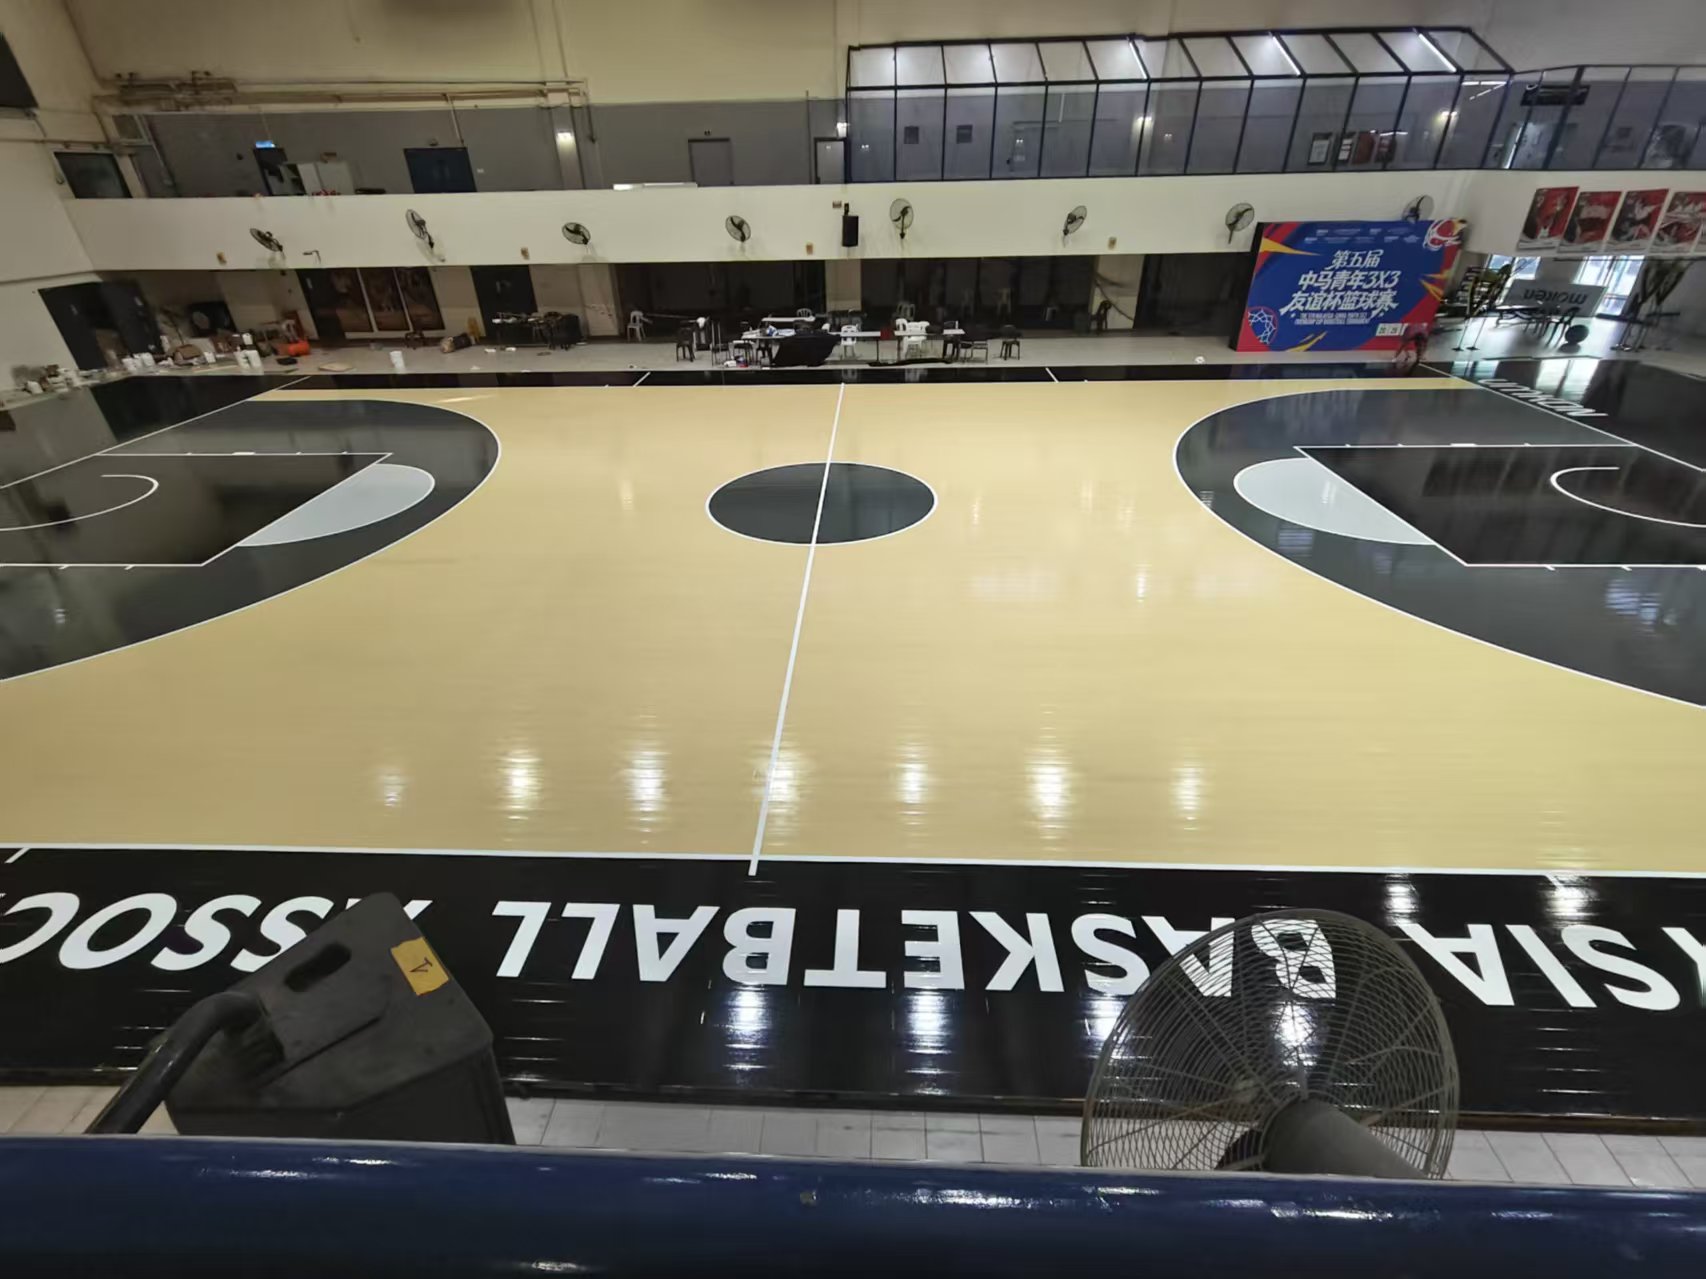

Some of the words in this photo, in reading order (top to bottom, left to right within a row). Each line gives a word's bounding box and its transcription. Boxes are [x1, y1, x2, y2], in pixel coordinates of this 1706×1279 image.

[1325, 249, 1384, 270] 第五届
[1298, 270, 1402, 290] 中马青年3X3
[1279, 290, 1400, 317] 友谊杯篮球赛
[0, 891, 434, 973] SSOC
[491, 899, 1337, 1000] BASKETBALL
